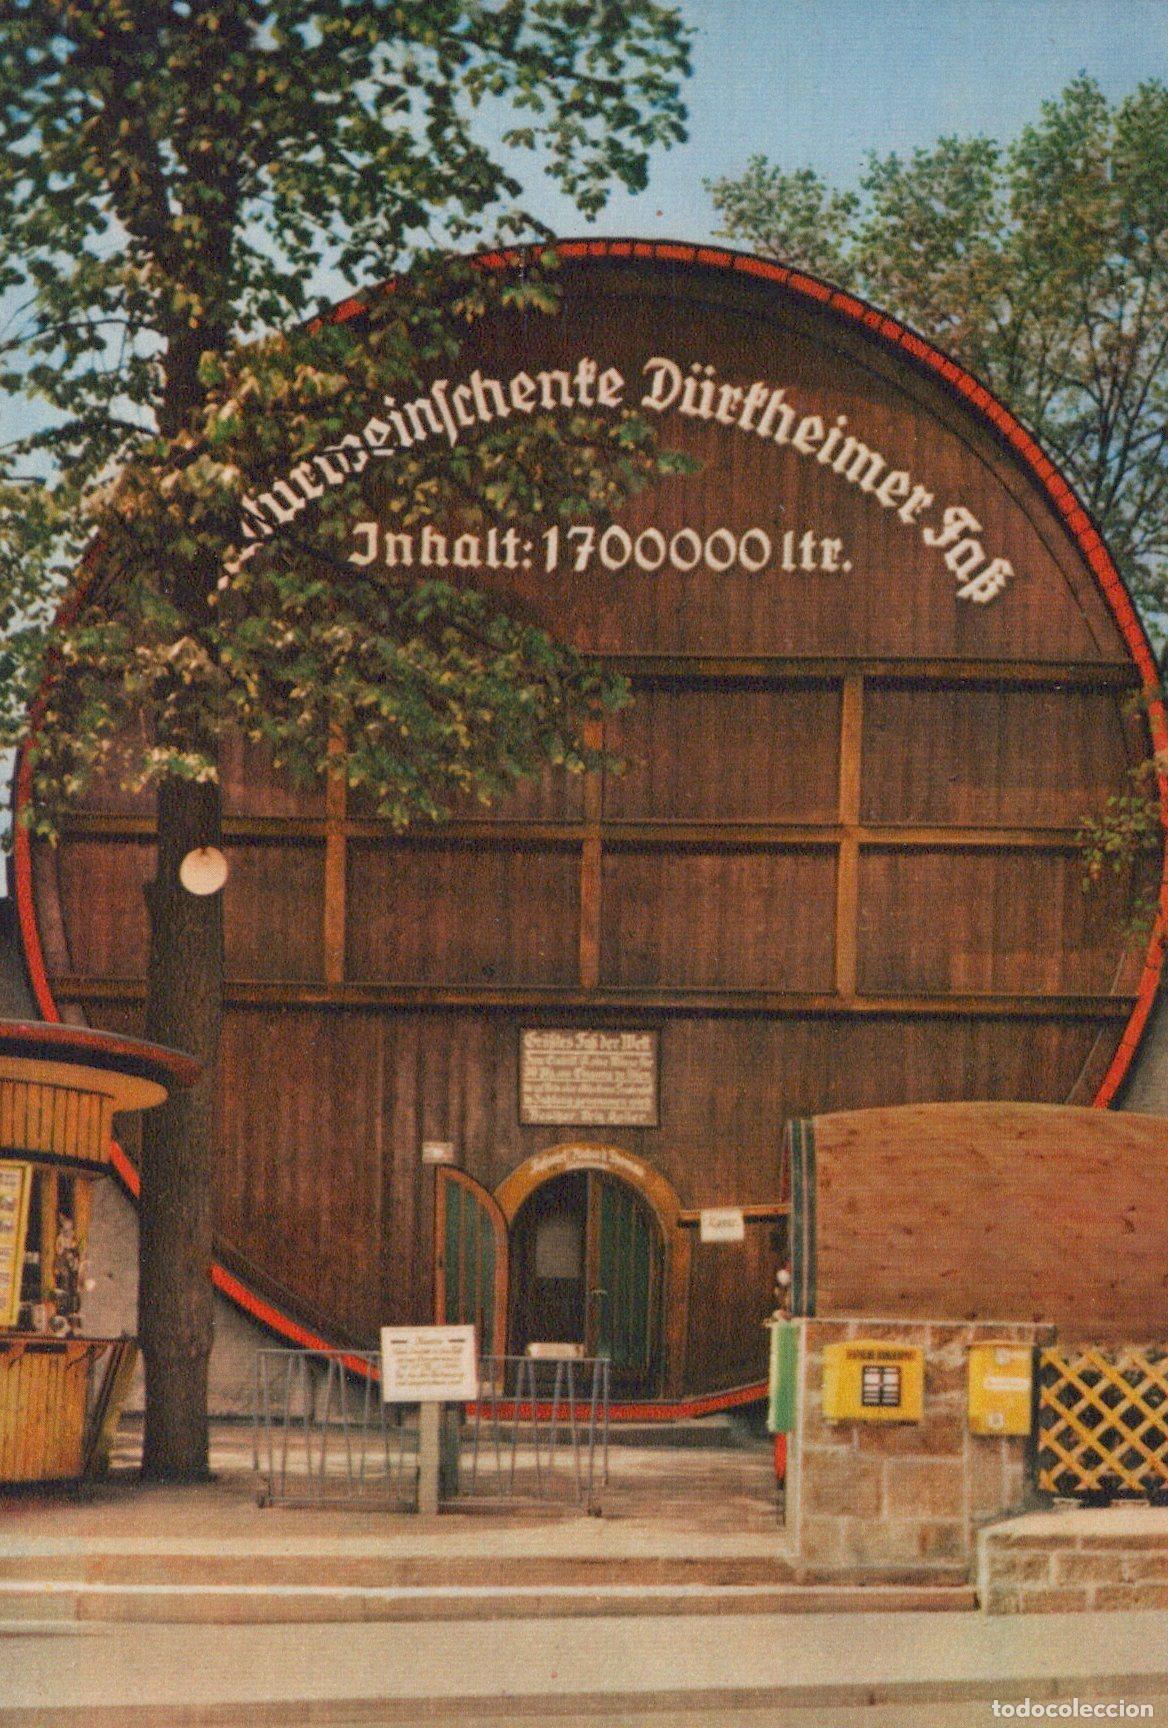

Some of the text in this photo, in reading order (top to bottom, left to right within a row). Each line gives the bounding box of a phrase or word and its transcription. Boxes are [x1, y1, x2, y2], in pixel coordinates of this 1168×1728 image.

[641, 356, 934, 525] Dürkheimer
[347, 522, 853, 573] Inhalt: 1700000 ltr.
